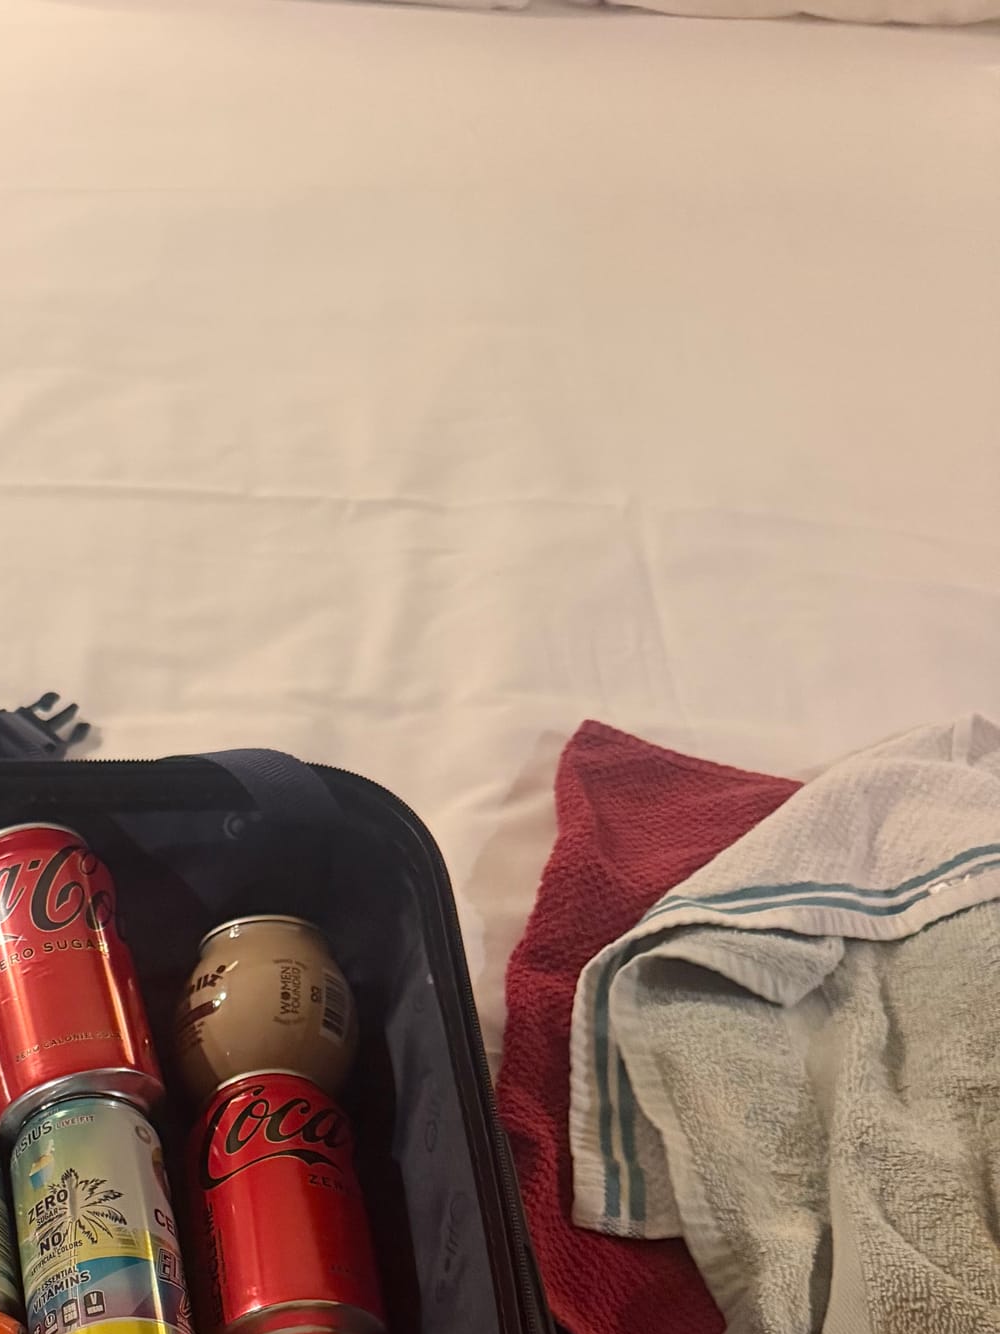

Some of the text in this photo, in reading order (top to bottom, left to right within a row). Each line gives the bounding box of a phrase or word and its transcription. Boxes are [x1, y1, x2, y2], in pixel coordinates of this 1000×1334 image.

[28, 1189, 69, 1225] ZERO
[36, 1207, 59, 1227] SUGAR
[39, 1232, 63, 1256] NO
[57, 1240, 84, 1255] COLORS
[33, 1271, 91, 1312] VITAMINS
